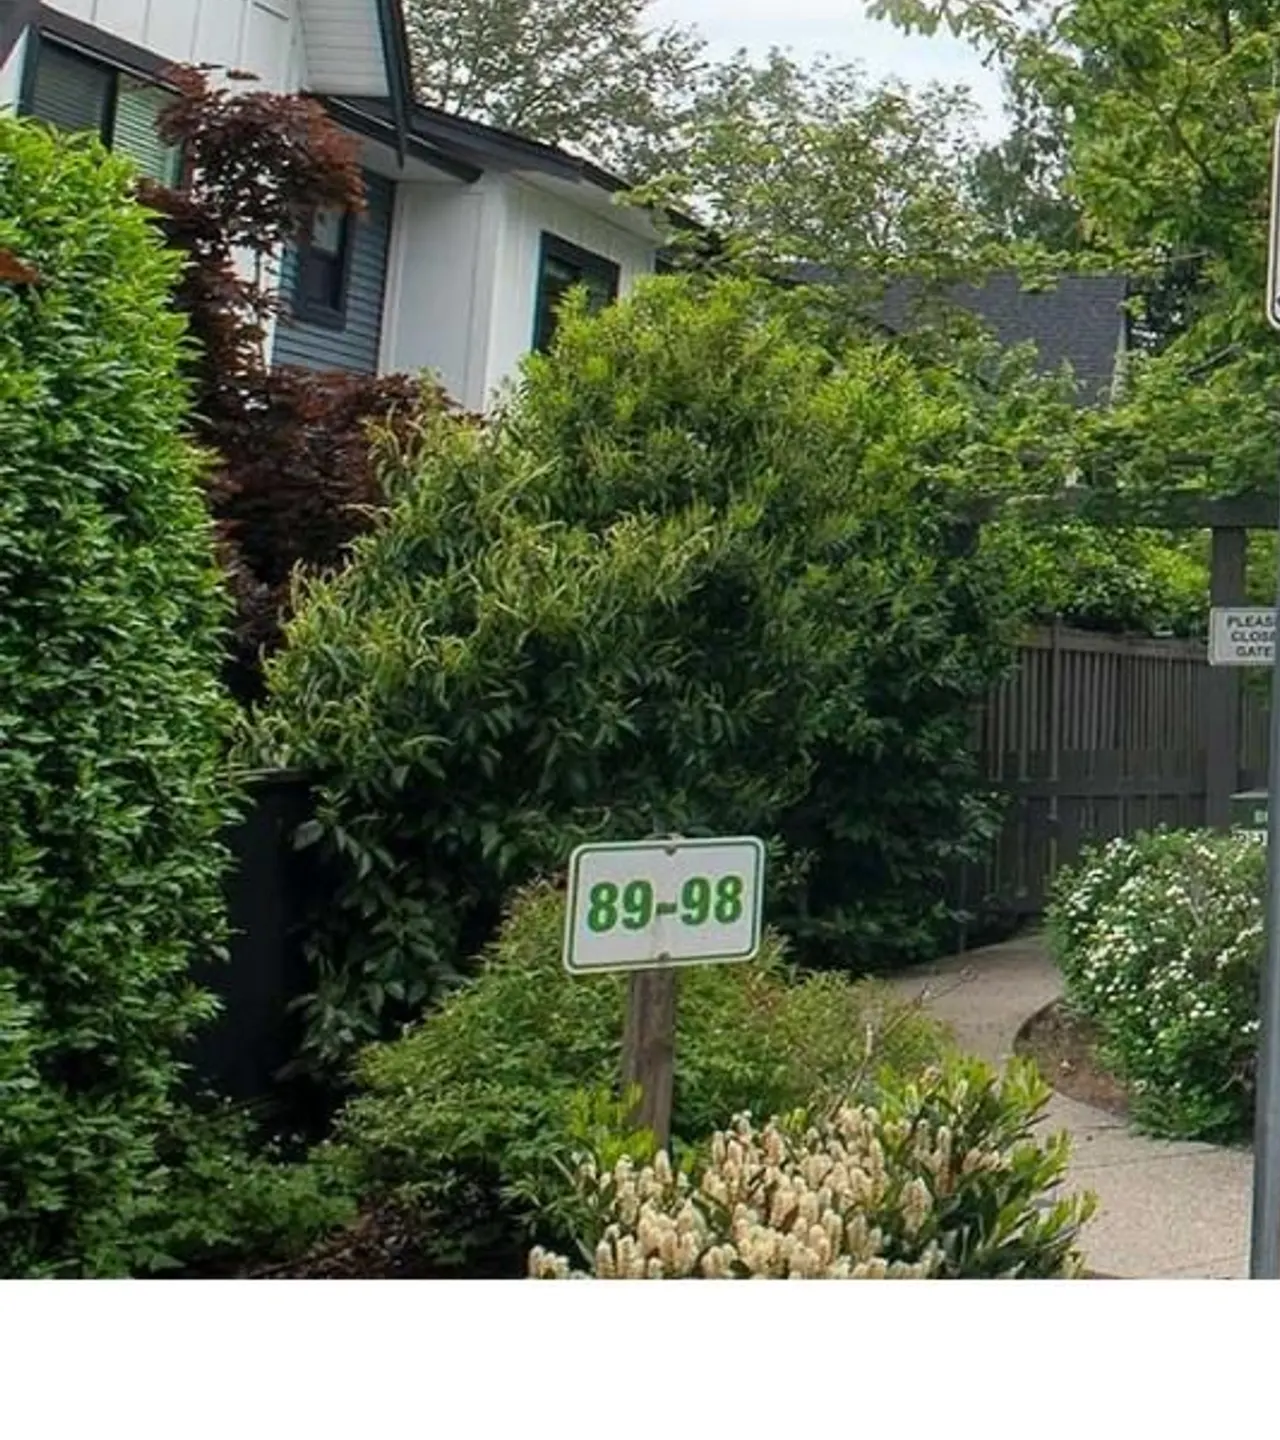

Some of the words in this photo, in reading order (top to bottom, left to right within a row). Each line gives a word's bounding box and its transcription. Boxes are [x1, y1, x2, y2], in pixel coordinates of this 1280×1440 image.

[1227, 614, 1275, 627] PLEAS
[1236, 645, 1272, 657] GATE
[587, 876, 743, 933] 89-98
